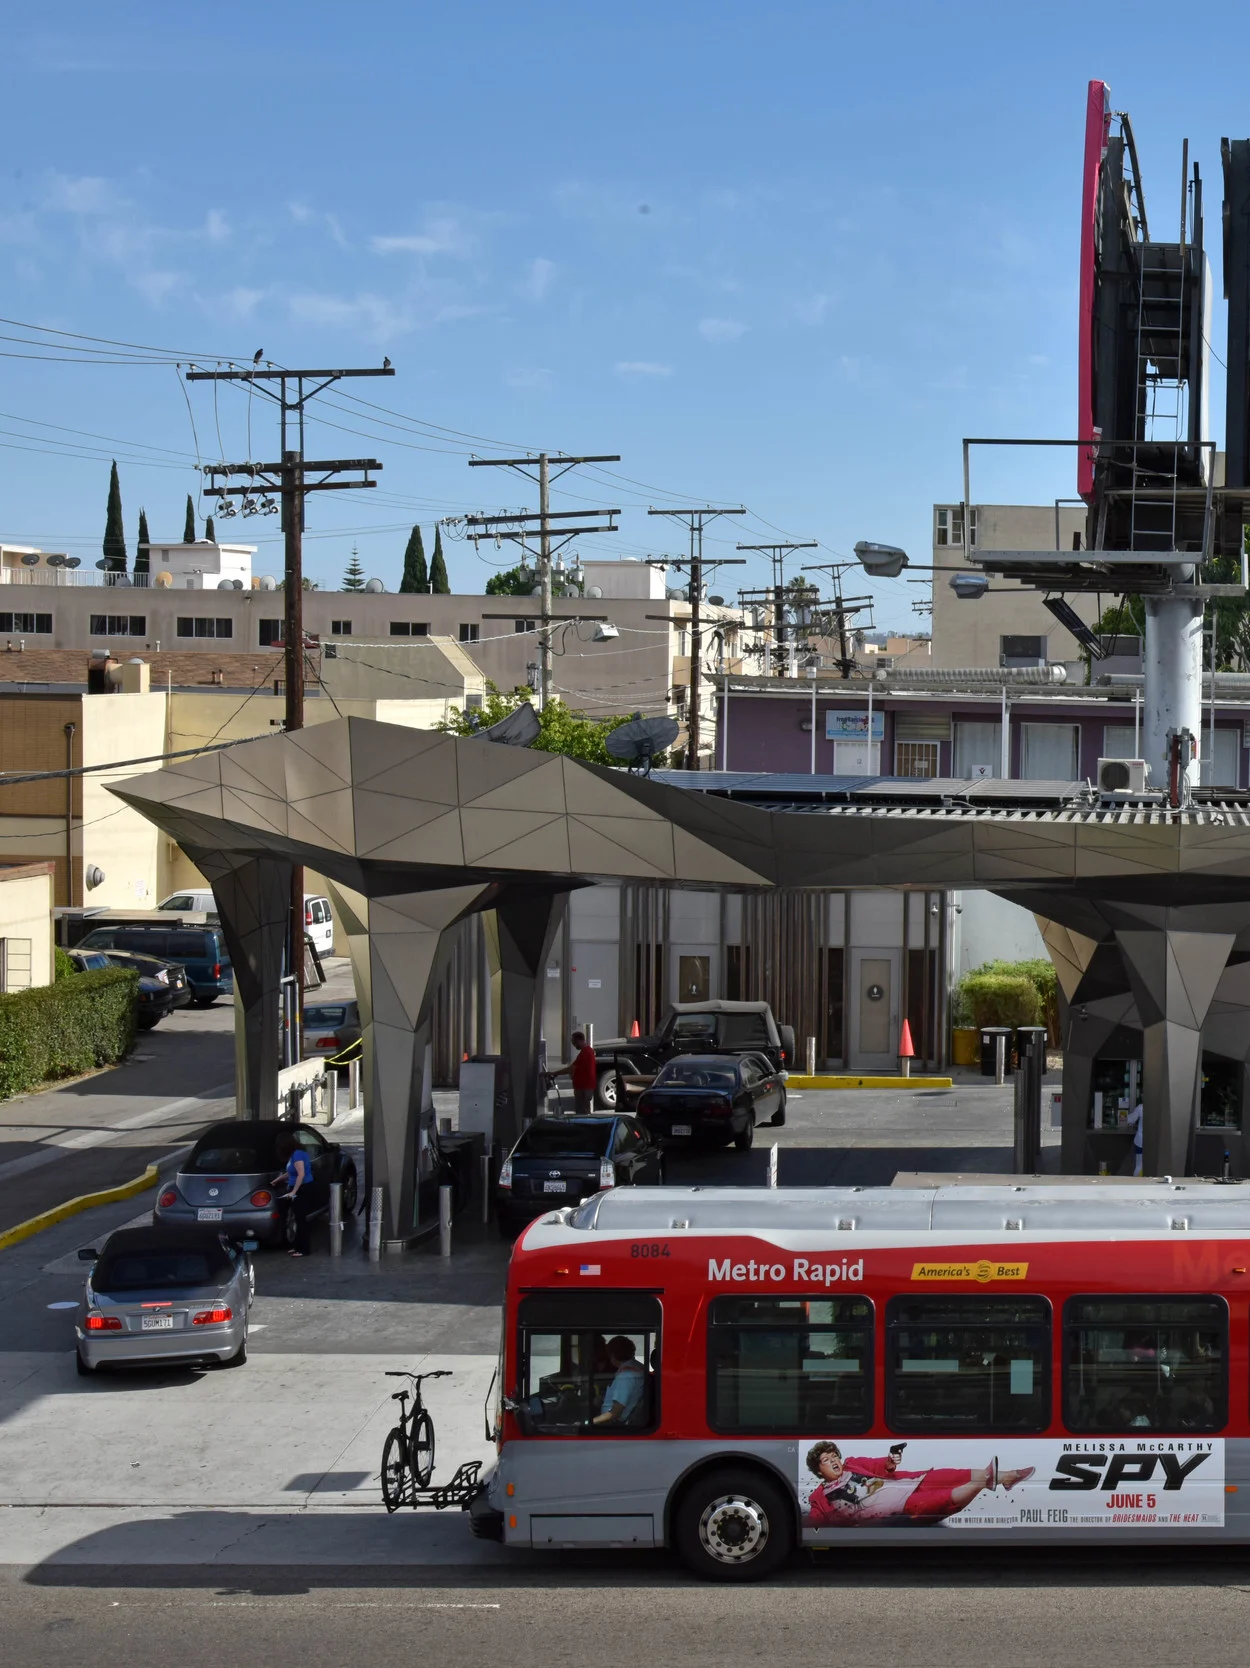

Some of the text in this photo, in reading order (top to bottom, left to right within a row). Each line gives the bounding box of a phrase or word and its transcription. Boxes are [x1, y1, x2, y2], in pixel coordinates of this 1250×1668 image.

[630, 1244, 671, 1259] 8084
[707, 1258, 865, 1287] Metro Rapid
[918, 1266, 971, 1277] America's
[997, 1266, 1021, 1276] Best
[1063, 1443, 1213, 1452] MELISSA McCARTHY
[1048, 1453, 1212, 1491] SPY
[1105, 1493, 1157, 1509] JUNE 5
[948, 1516, 962, 1524] FROM
[964, 1516, 982, 1524] WRITER
[984, 1516, 994, 1524] AND
[995, 1516, 1018, 1524] DIRECTOR
[1020, 1508, 1044, 1523] PAUL
[1047, 1508, 1069, 1523] FEIG
[1070, 1515, 1079, 1524] THE
[1080, 1515, 1104, 1524] DIRECTOR
[1105, 1515, 1112, 1524] OF
[1112, 1513, 1157, 1523] BRIDESMAIDS
[1169, 1513, 1183, 1523] THE
[1184, 1513, 1200, 1523] HEAT
